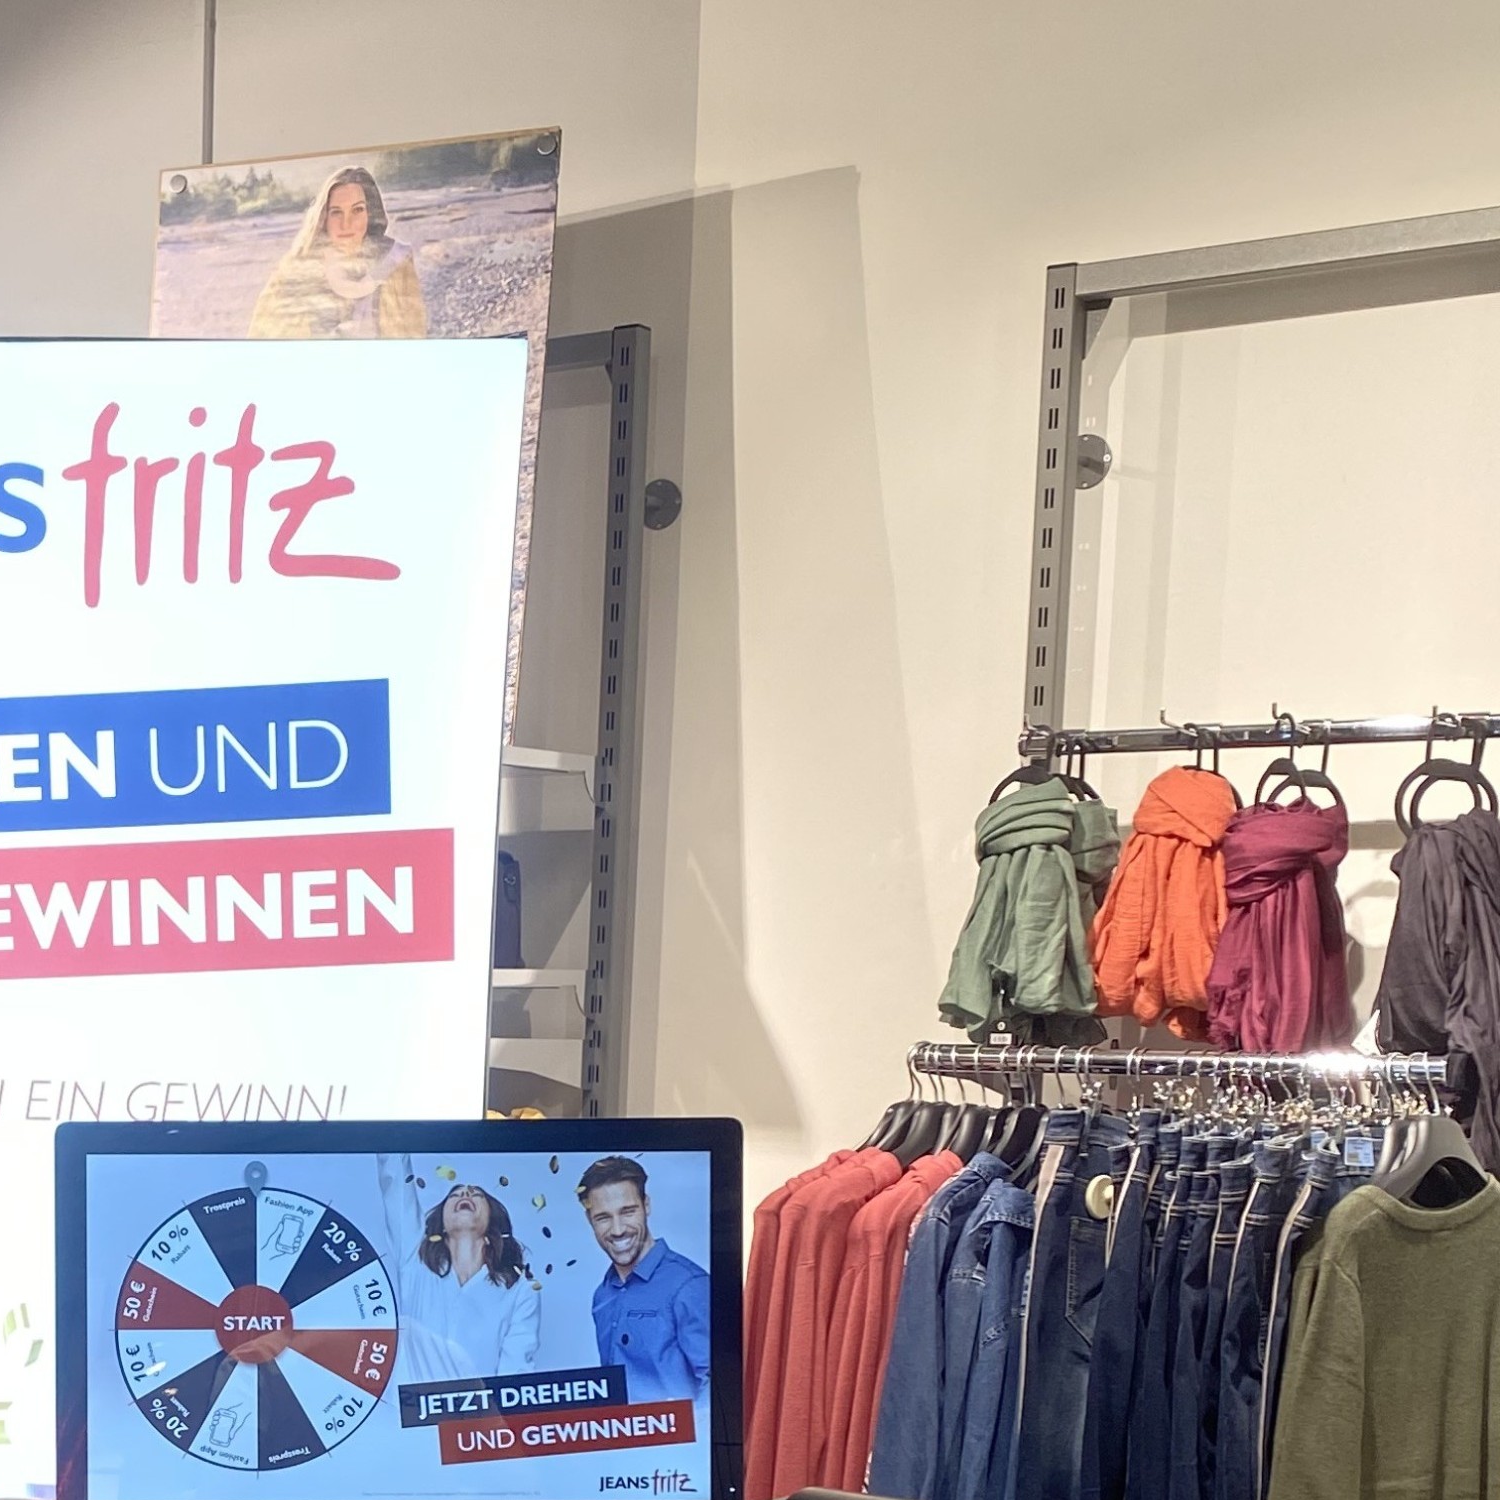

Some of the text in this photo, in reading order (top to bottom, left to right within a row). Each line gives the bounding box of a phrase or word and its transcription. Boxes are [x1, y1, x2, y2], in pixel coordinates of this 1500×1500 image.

[148, 719, 350, 797] UND
[25, 1079, 106, 1122] EIN
[125, 1080, 348, 1122] GEWINN!
[264, 1196, 315, 1217] Fashion App
[151, 1225, 189, 1262] 10 %
[322, 1221, 362, 1262] 20 %
[123, 1280, 146, 1320] 50 €
[365, 1279, 387, 1317] 10 €
[223, 1315, 285, 1331] START
[125, 1344, 148, 1383] 10 €
[364, 1341, 388, 1381] 50 €
[150, 1398, 189, 1439] 20 %
[325, 1397, 363, 1434] 10 %
[418, 1378, 609, 1421] JETZT DREHEN
[456, 1413, 677, 1452] UND GEWINNEN!
[200, 1445, 249, 1465] Fashion App
[268, 1446, 311, 1464] Trostpreis
